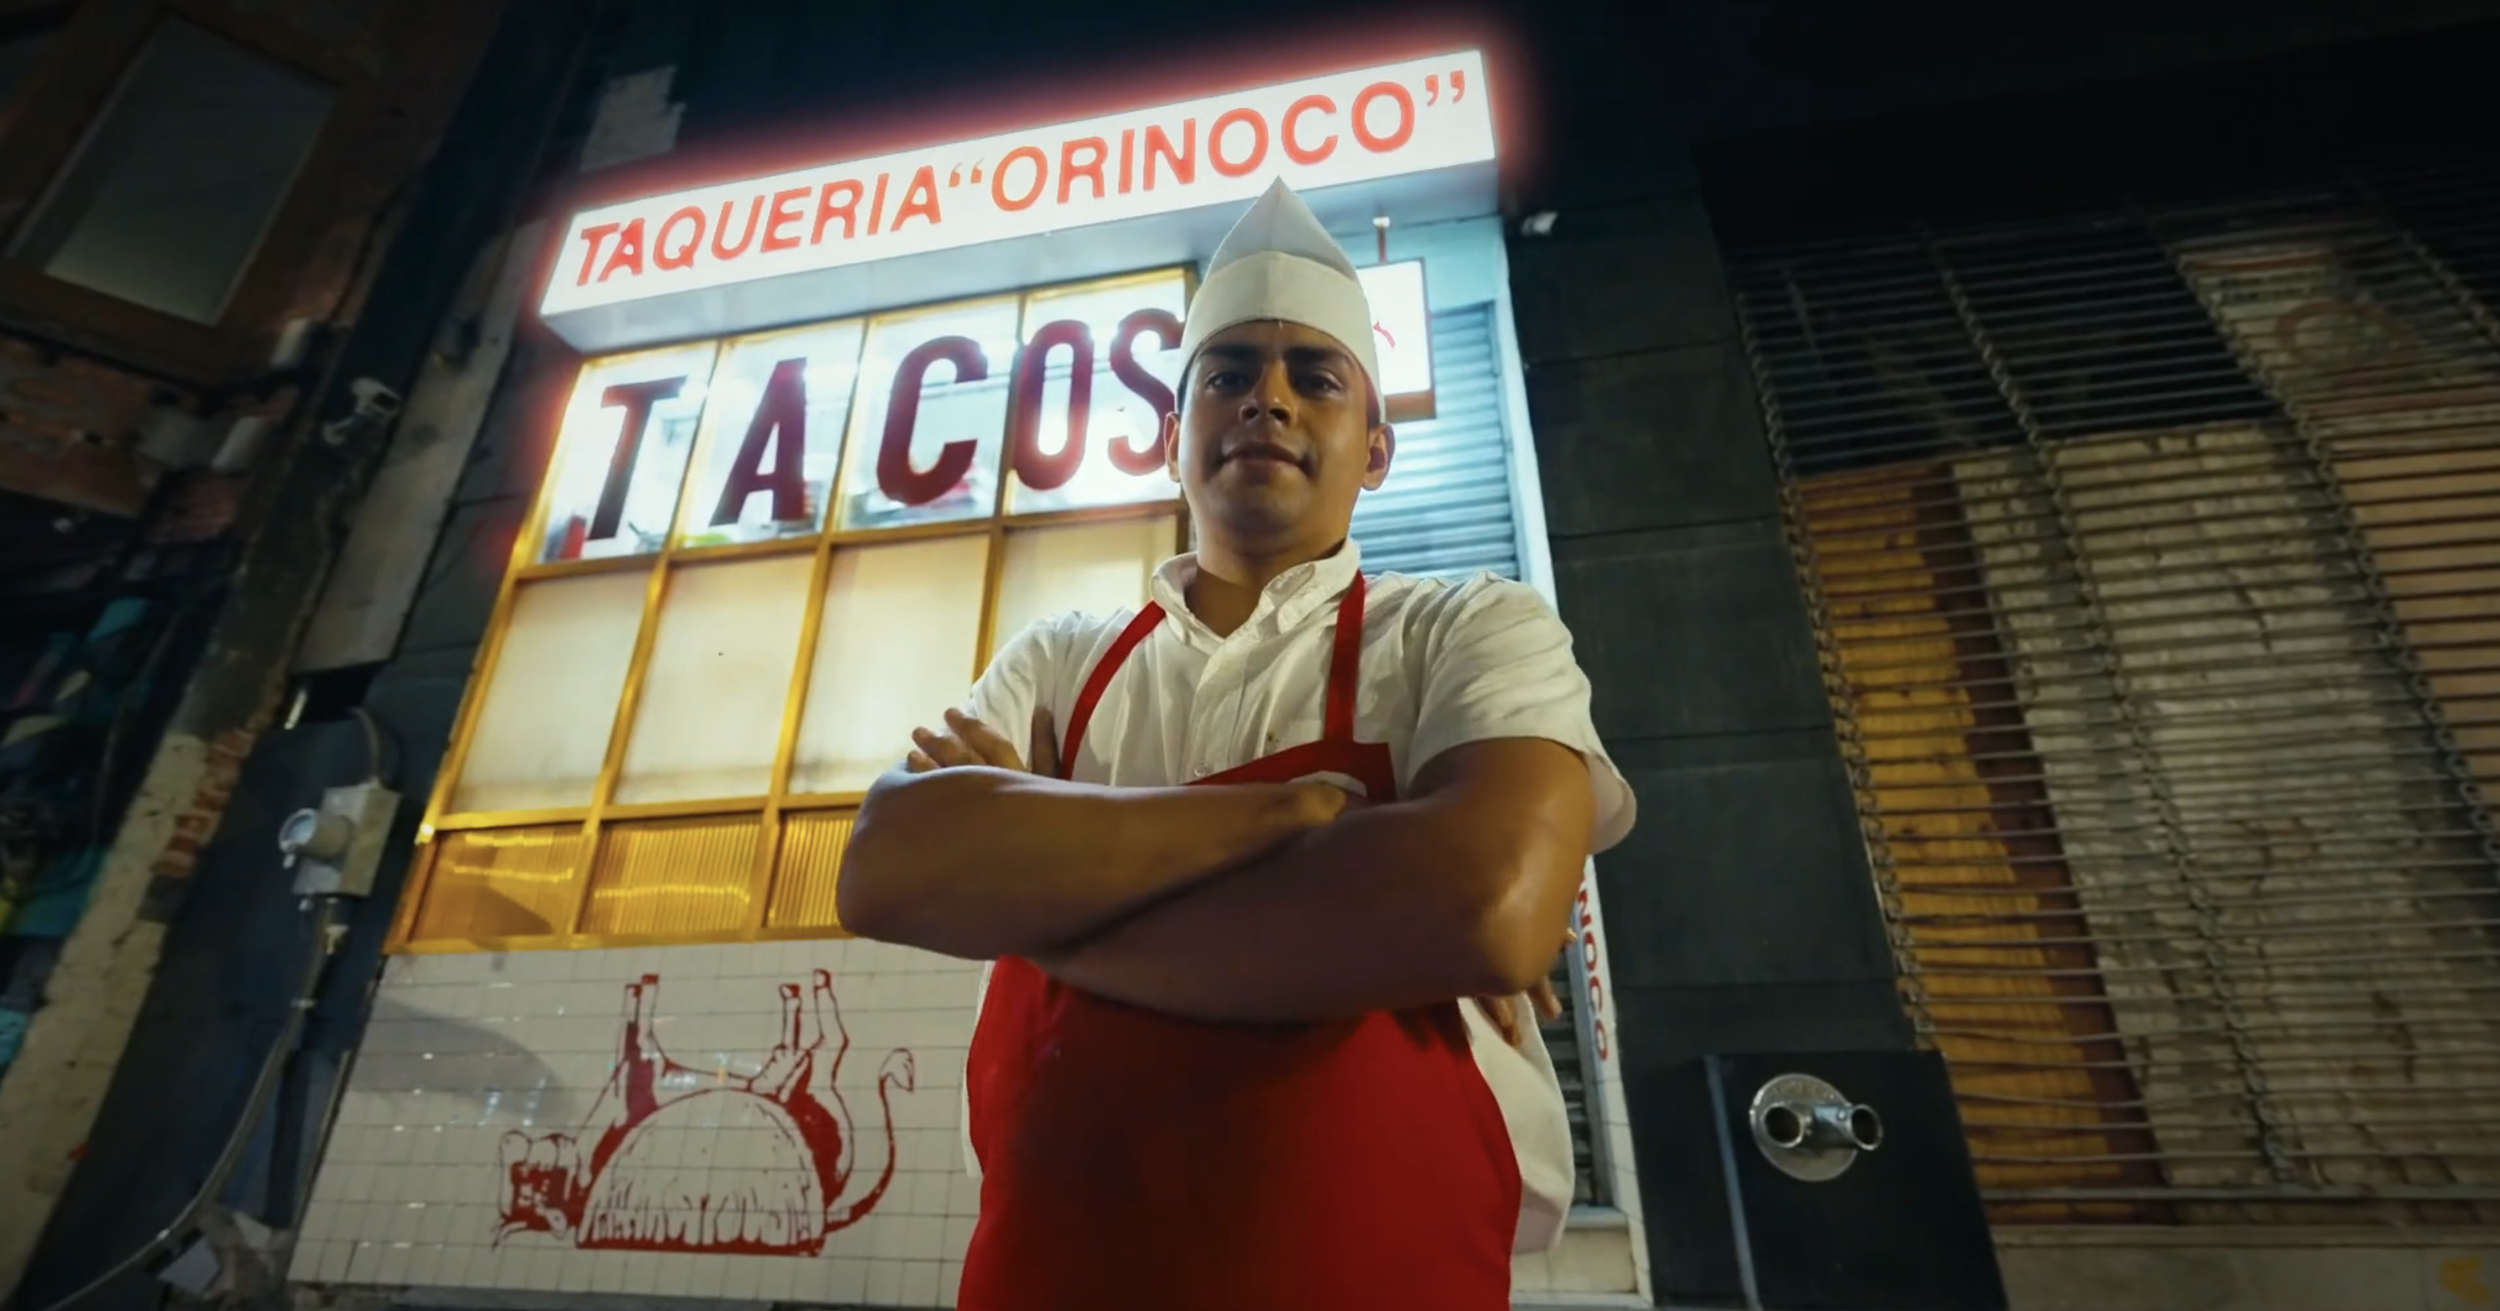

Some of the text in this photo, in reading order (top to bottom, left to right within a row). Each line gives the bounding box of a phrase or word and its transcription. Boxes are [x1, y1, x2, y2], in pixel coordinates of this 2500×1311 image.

[576, 165, 942, 287] TAQUERIA
[588, 308, 1186, 541] TACOS
[1577, 873, 1608, 1061] NOCO
